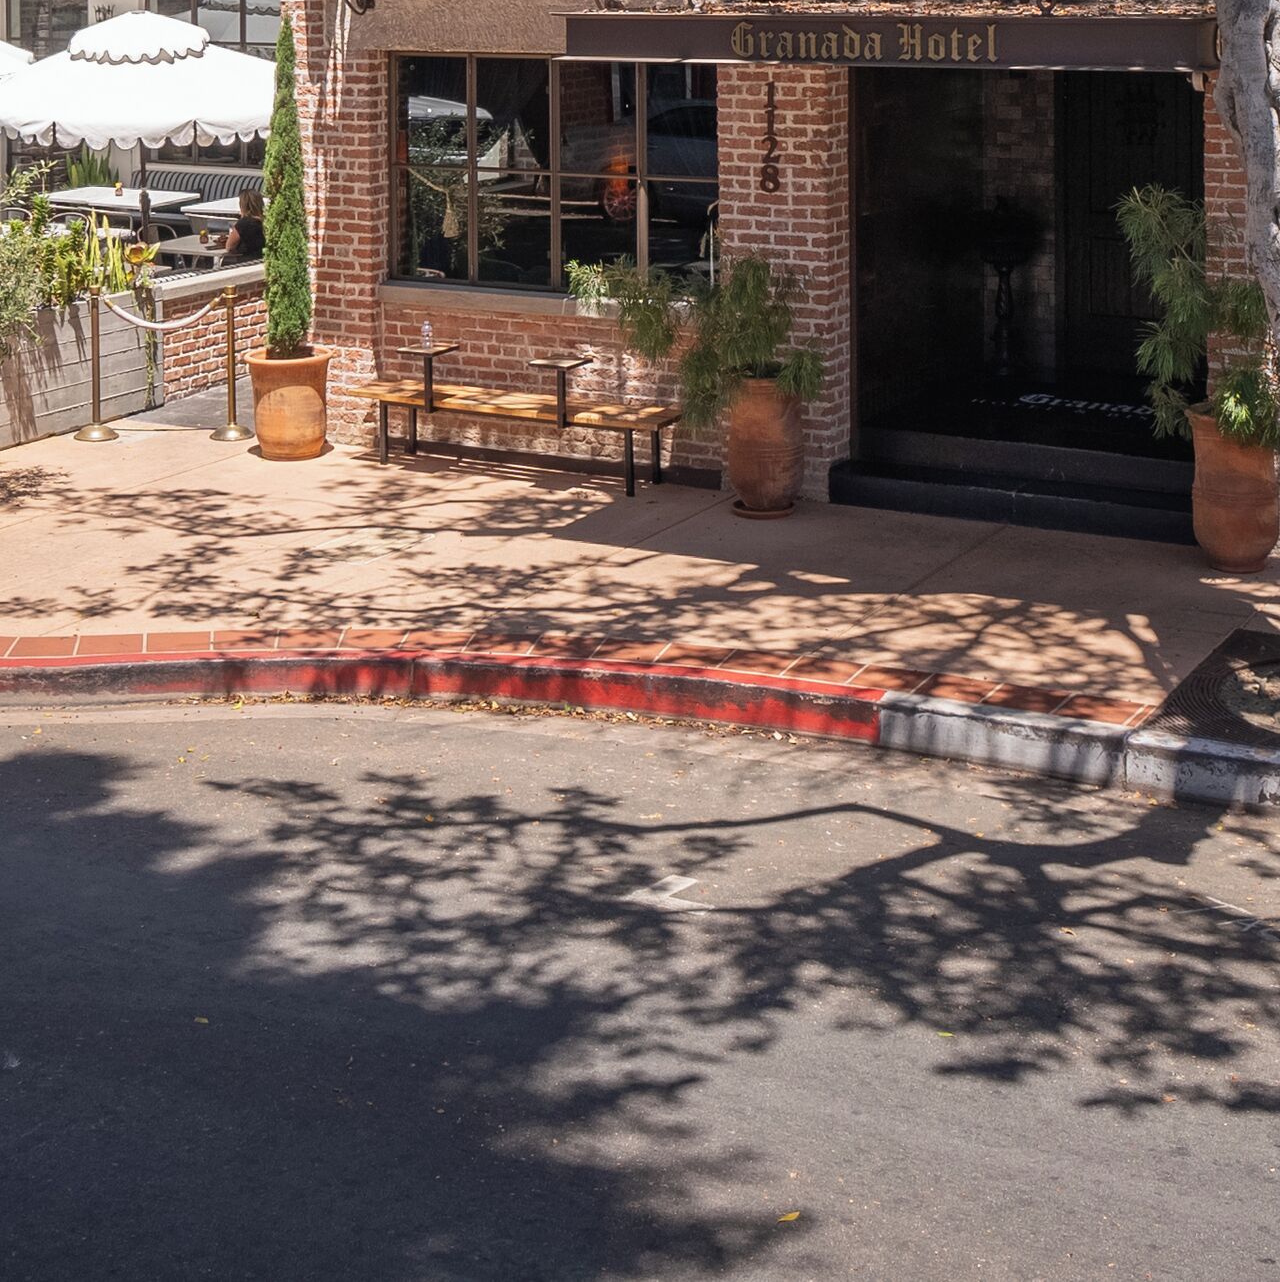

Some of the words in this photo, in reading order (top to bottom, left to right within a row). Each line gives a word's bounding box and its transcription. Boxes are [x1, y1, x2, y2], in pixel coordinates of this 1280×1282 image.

[731, 21, 883, 61] Granada
[897, 22, 999, 62] Hotel
[760, 81, 780, 193] 1128
